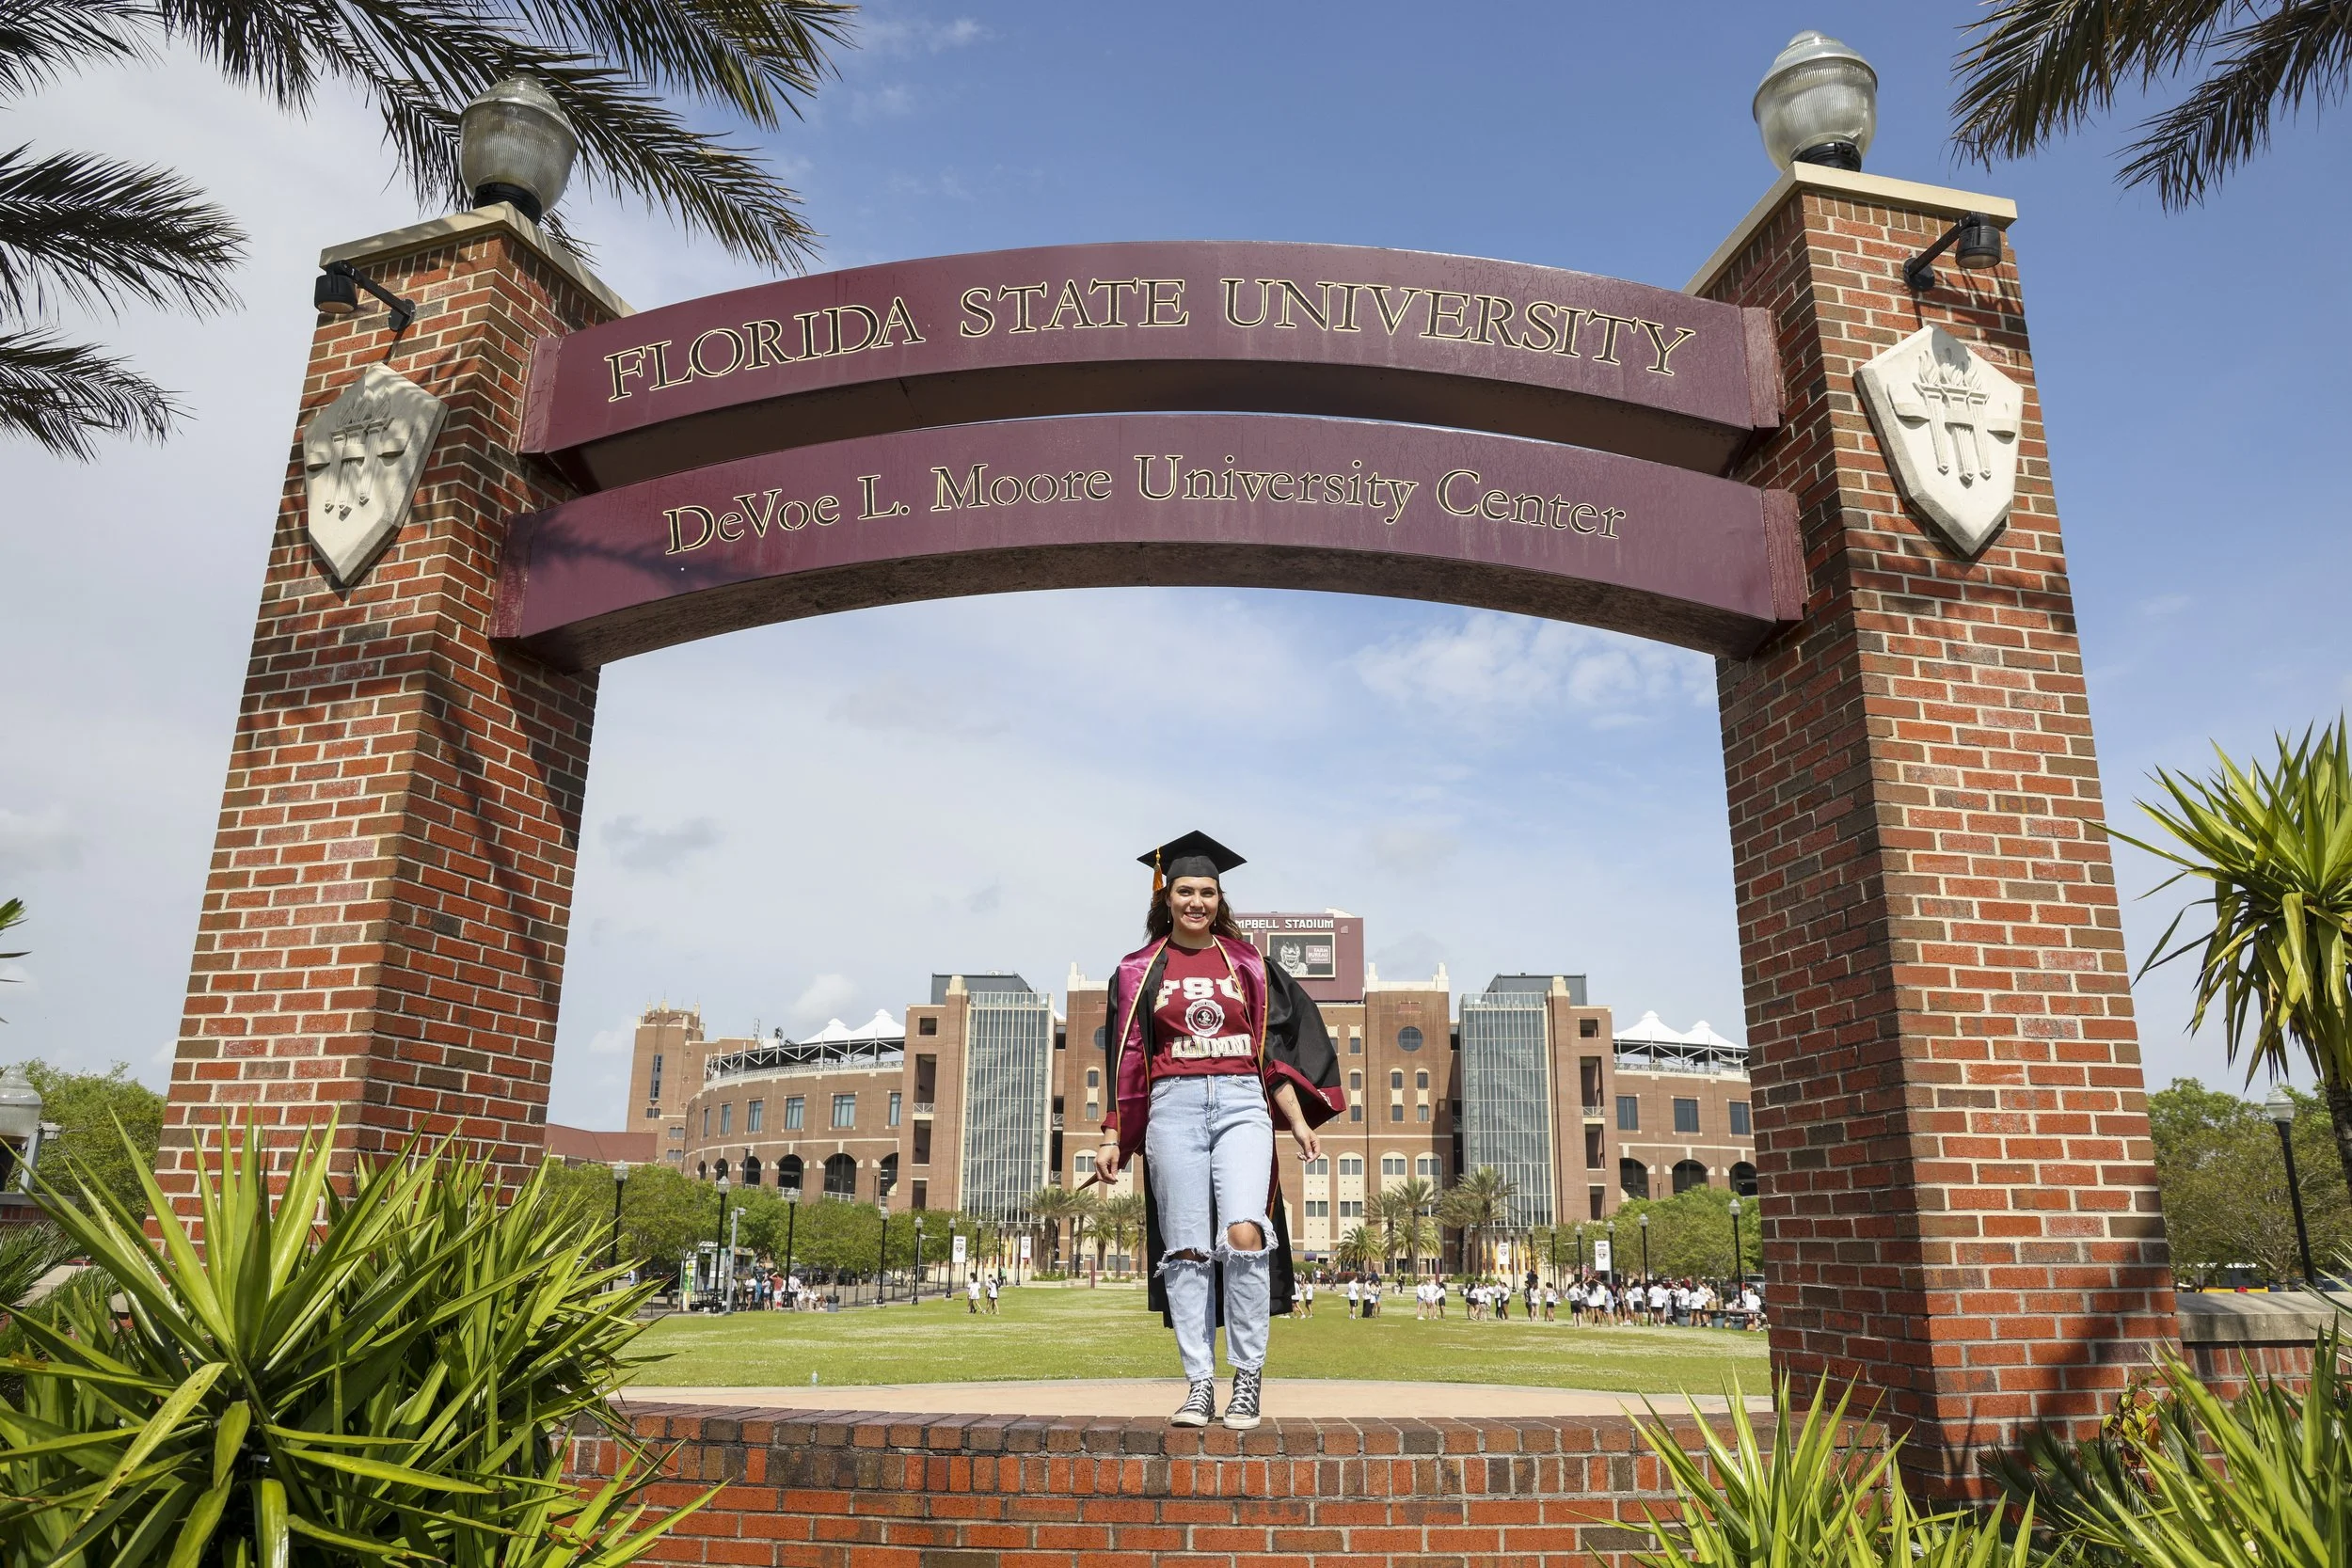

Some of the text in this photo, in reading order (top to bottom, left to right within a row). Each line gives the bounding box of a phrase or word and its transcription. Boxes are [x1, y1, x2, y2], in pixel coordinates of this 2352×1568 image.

[603, 277, 1695, 403] FLORIDA STATE UNIVERSITY
[664, 454, 1627, 556] DeVoe L. Moore University Center
[1234, 919, 1334, 929] MPBELL STADIUM
[1171, 1033, 1252, 1058] ALUMNI
